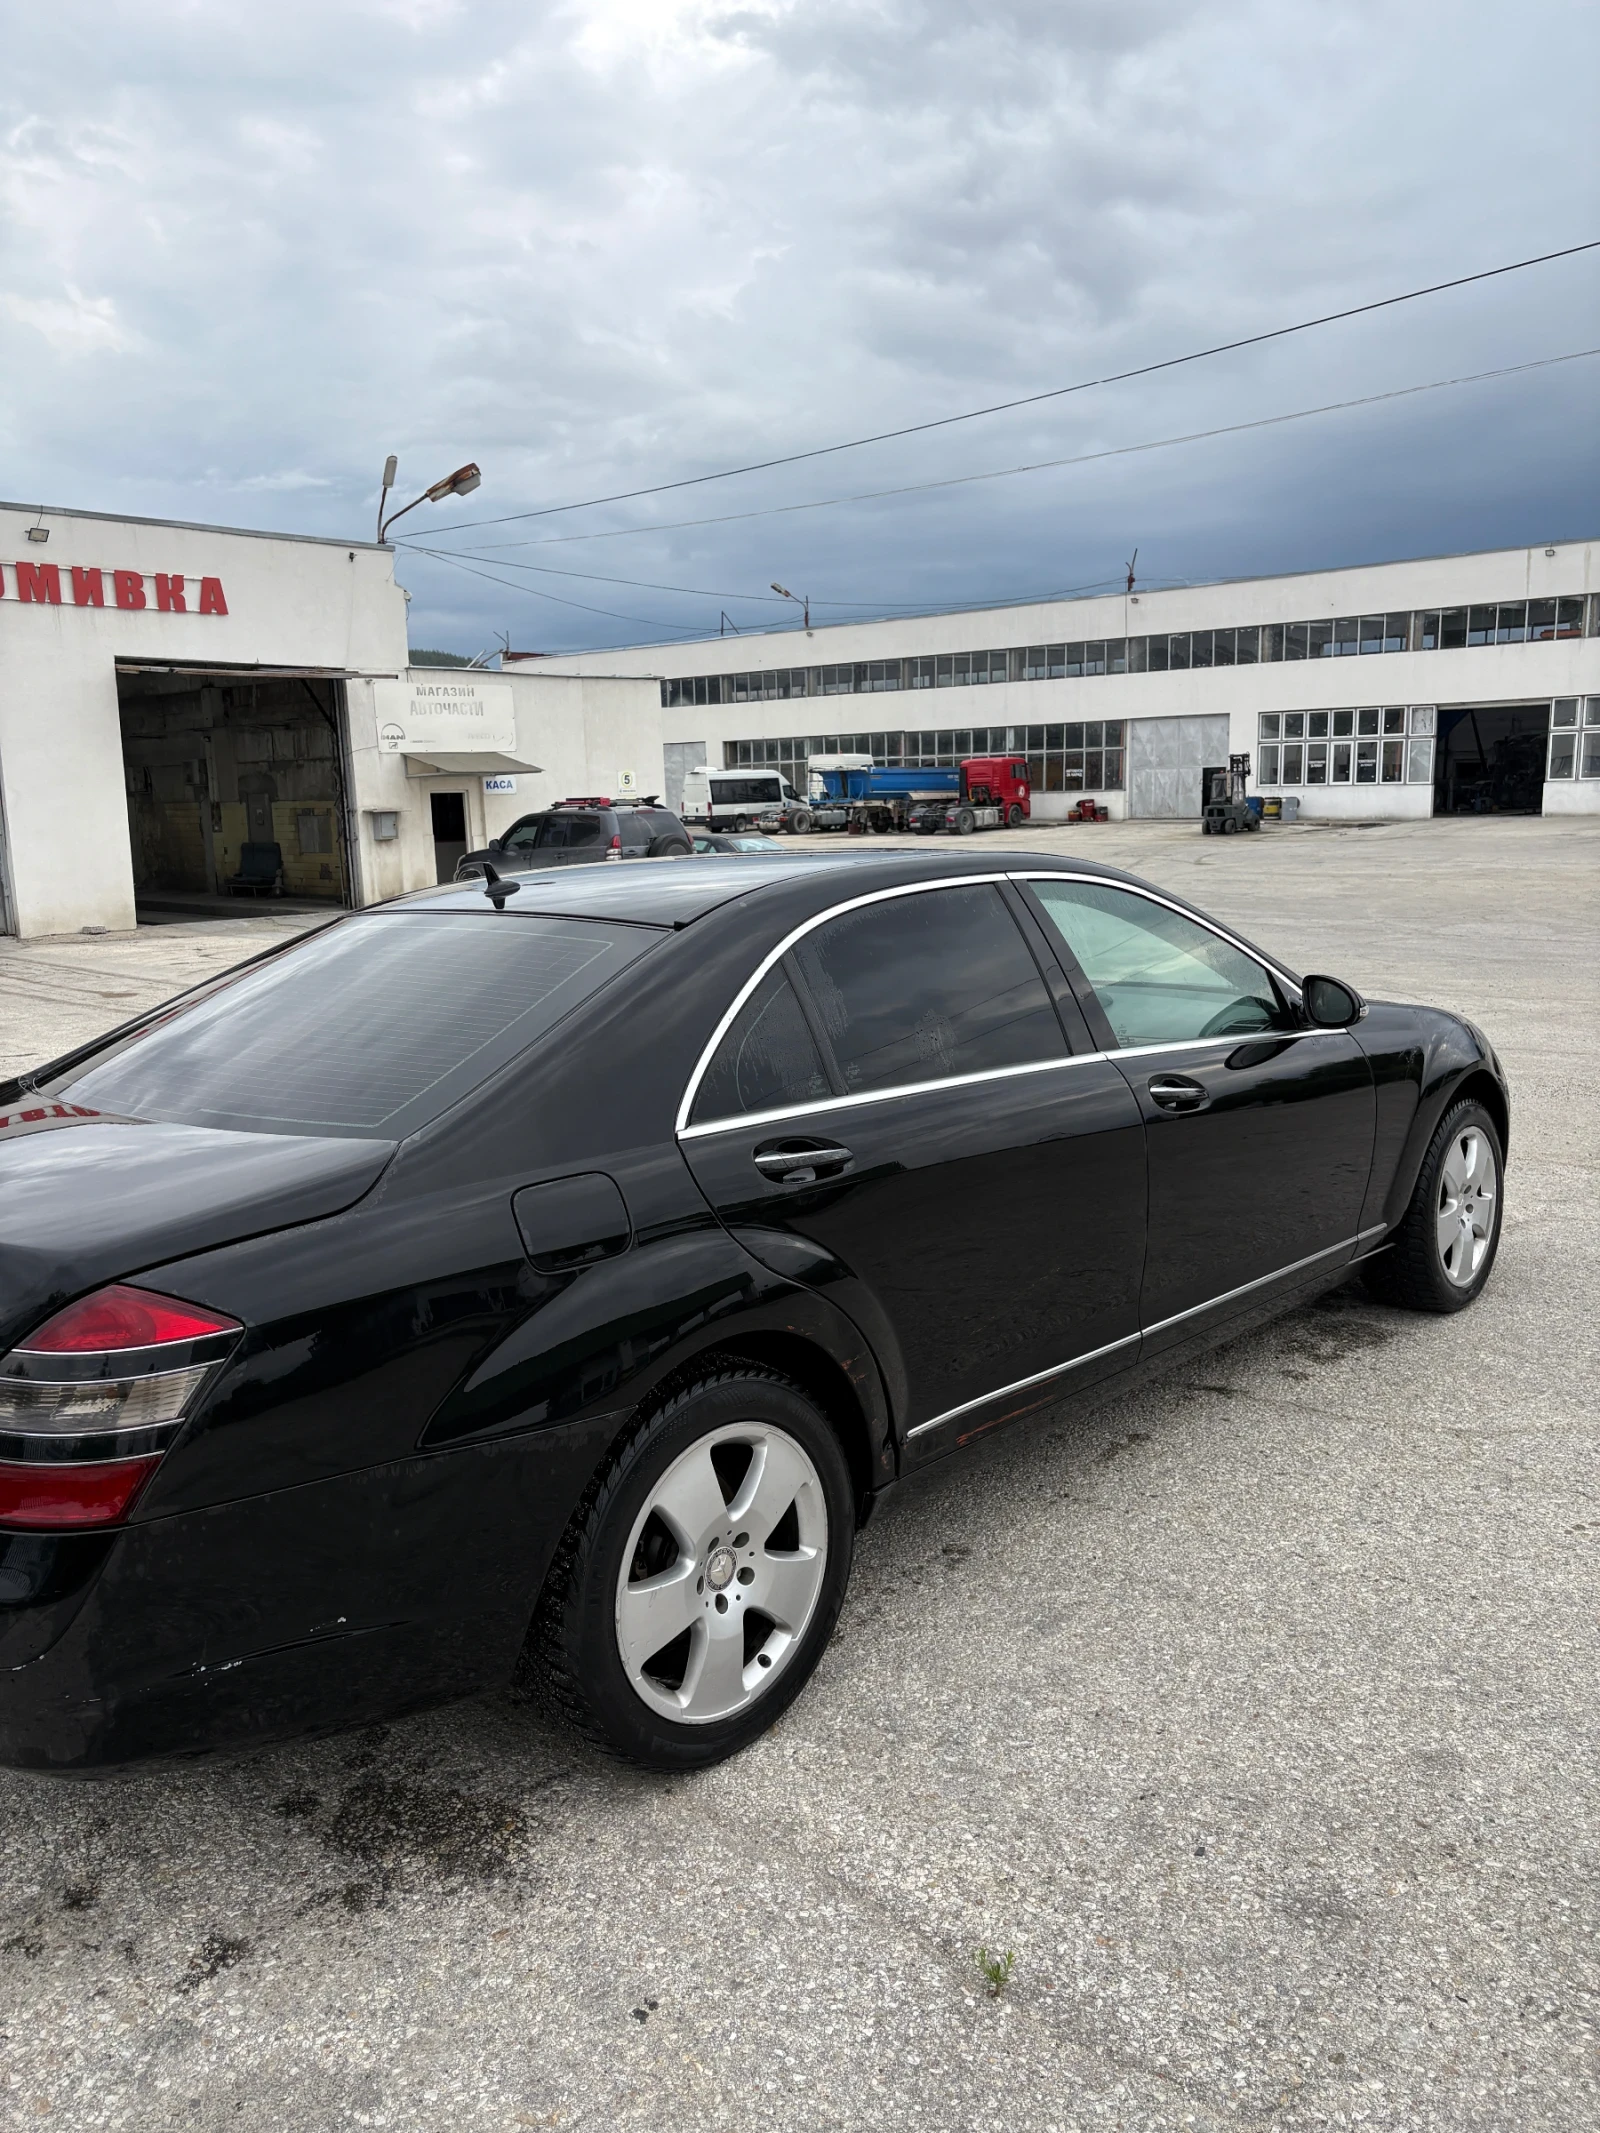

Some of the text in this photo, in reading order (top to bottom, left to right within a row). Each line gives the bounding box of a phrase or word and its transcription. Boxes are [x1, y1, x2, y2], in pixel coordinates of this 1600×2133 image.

[0, 561, 229, 615] МИВКА
[416, 686, 475, 697] МАГАЗИН
[410, 700, 484, 717] АВТОЧАСТИ
[485, 780, 513, 790] КАСА
[624, 774, 631, 785] 5
